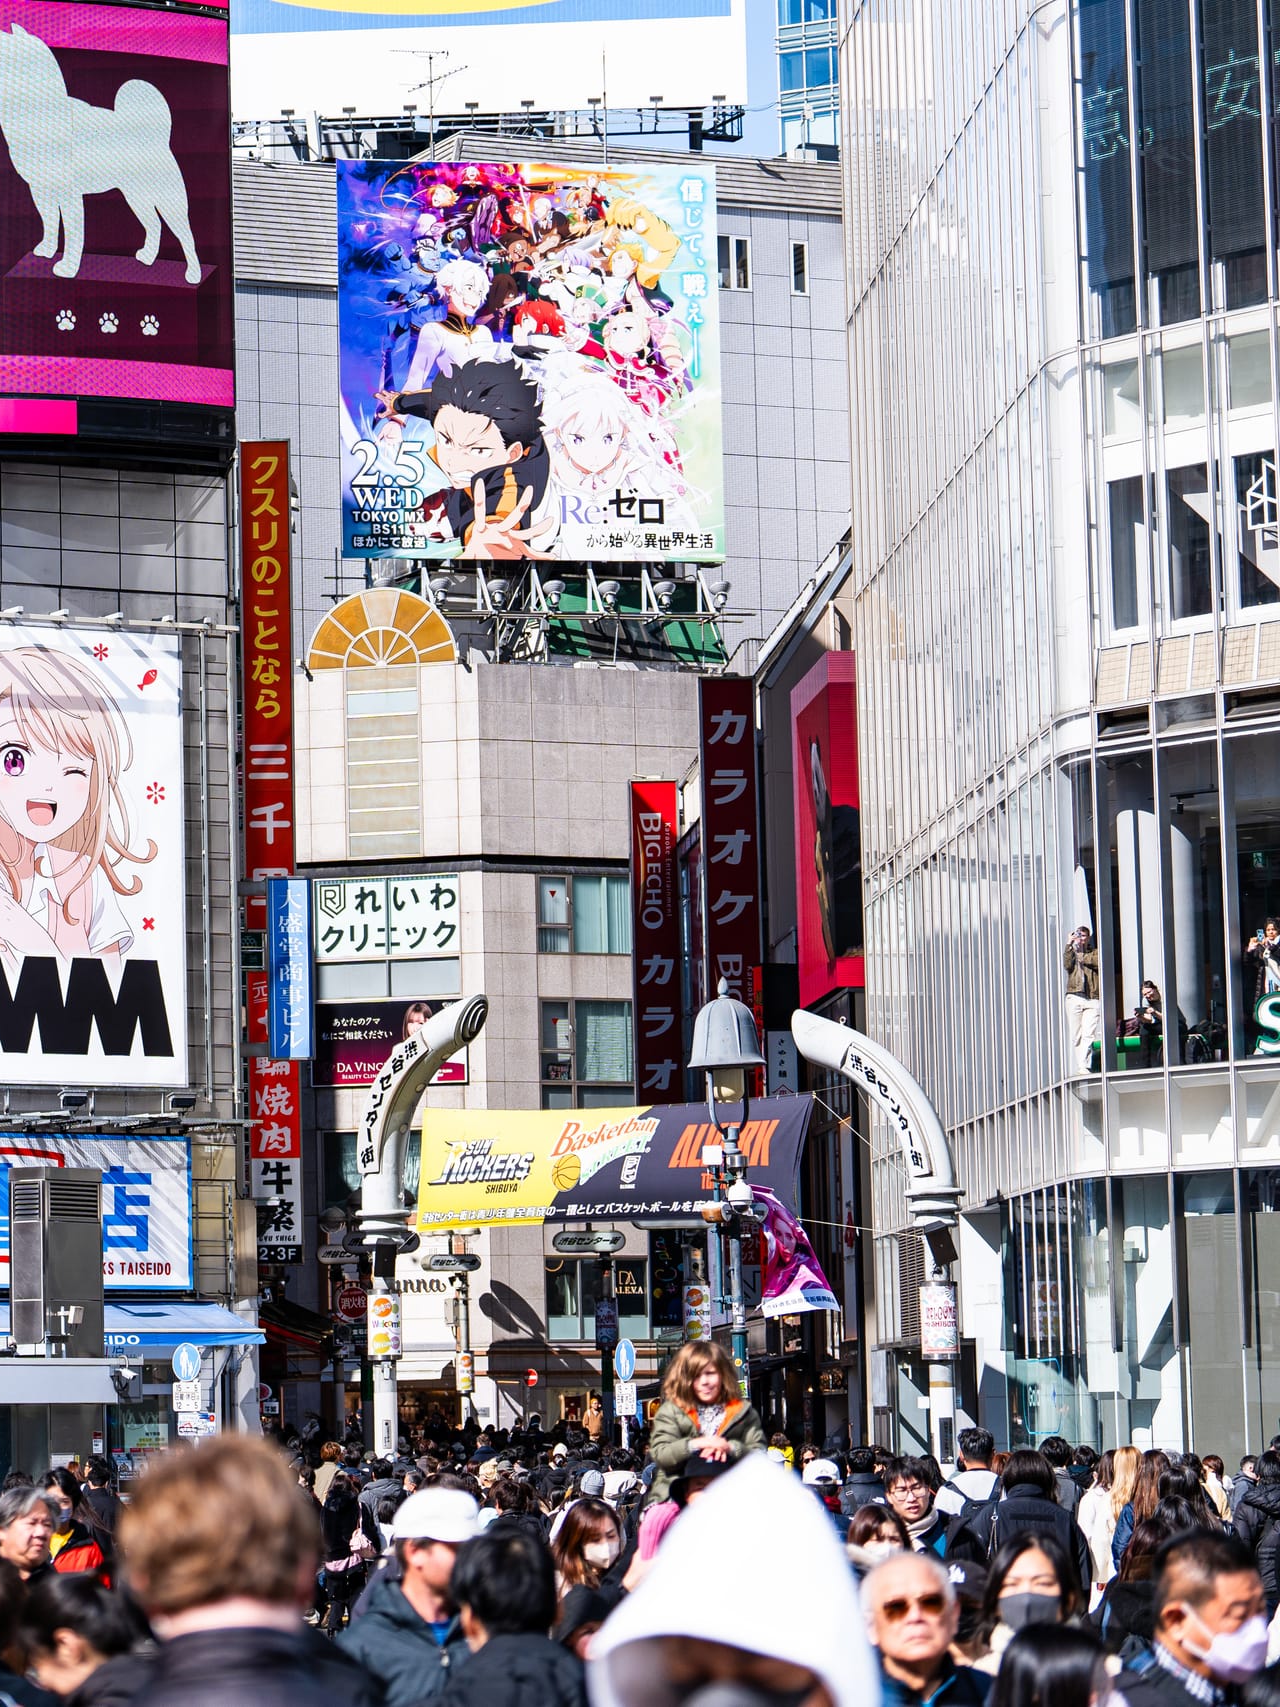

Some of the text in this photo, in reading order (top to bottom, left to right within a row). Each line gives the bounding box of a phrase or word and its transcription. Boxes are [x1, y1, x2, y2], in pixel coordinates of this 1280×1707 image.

[351, 440, 425, 487] 2.5
[351, 487, 425, 510] WED
[560, 488, 665, 525] Re:ゼロ
[352, 510, 425, 523] TOKYO MX
[372, 523, 405, 535] BS11
[353, 536, 426, 549] ほかにて放送
[586, 530, 714, 551] から始める異世界生活
[250, 456, 282, 719] クスリのことなら
[708, 749, 753, 926] カラオケ
[639, 812, 665, 930] BIG ECHO
[354, 882, 457, 915] れいわ
[321, 920, 457, 953] クリニック
[278, 888, 305, 1050] 大盛堂商事ビル
[333, 1016, 381, 1028] あなたのクマ
[336, 1062, 384, 1073] DA VINC
[360, 1040, 418, 1169] 渋谷センター街
[849, 1053, 924, 1170] 渋谷センター街
[551, 1117, 657, 1157] Basketball
[429, 1145, 535, 1186] ROCKERS
[484, 1182, 519, 1195] SHIBUYA
[275, 1233, 297, 1242] SHIGE
[558, 1236, 622, 1247] 渋谷センター街
[119, 1261, 173, 1276] TAISEIDO
[340, 1295, 368, 1309] 消火栓
